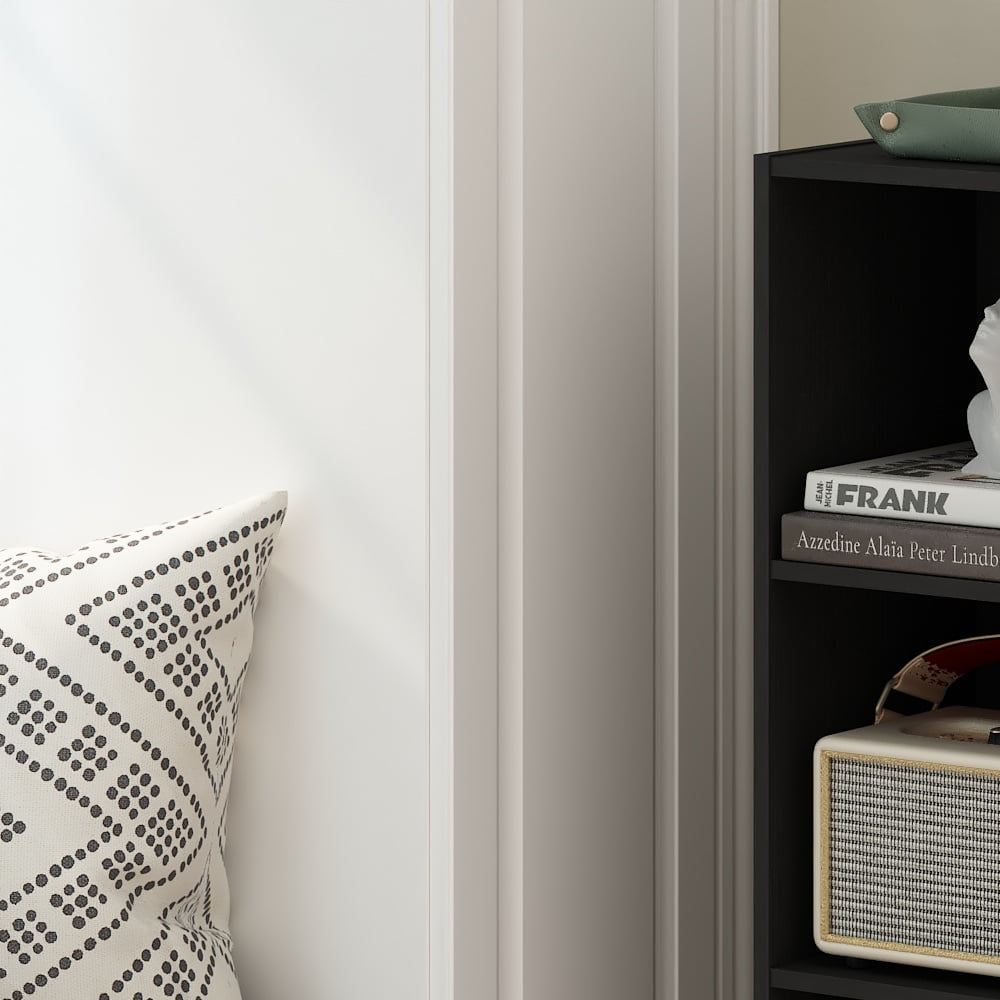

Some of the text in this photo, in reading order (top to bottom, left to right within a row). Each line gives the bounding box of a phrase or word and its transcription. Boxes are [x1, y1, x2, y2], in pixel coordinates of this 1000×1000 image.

[815, 480, 823, 504] JEAN-
[824, 479, 833, 508] MICHEL
[836, 483, 950, 515] FRANK
[797, 530, 861, 554] Azzedine
[865, 535, 904, 558] Alaïa
[909, 541, 946, 562] Peter
